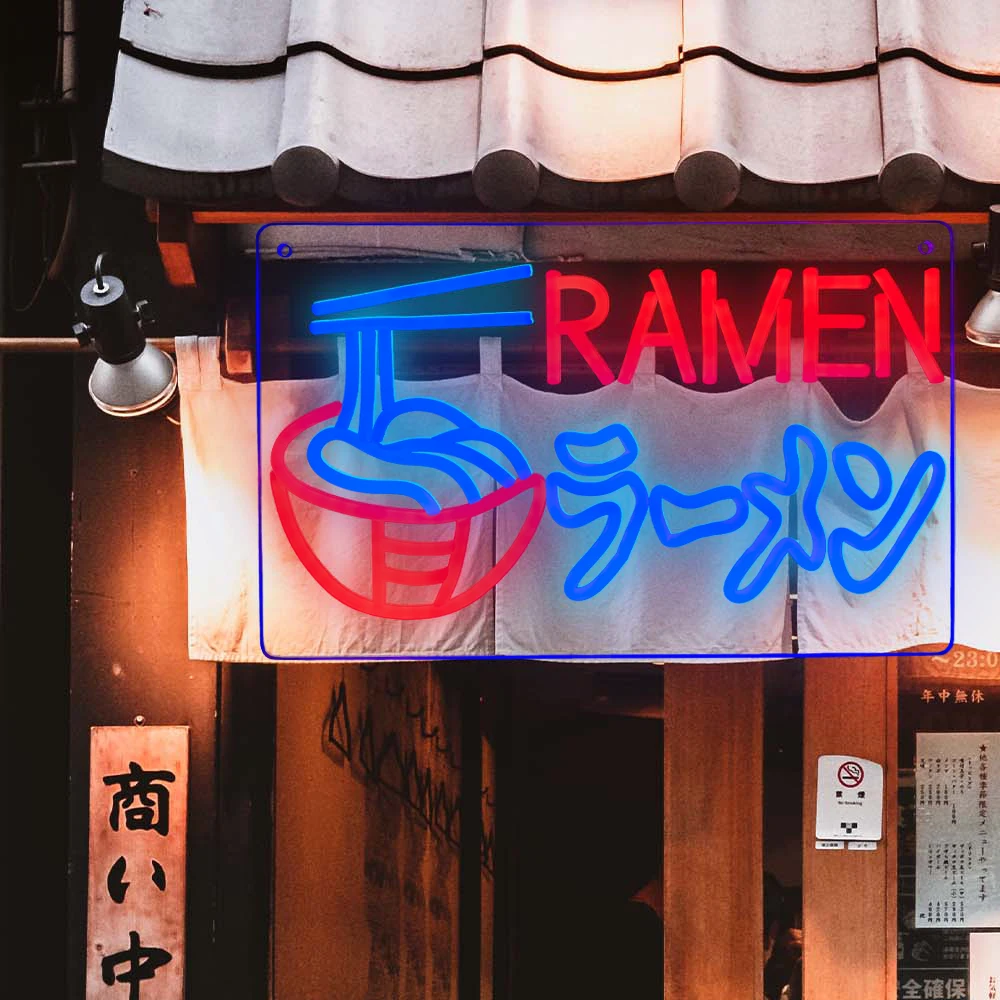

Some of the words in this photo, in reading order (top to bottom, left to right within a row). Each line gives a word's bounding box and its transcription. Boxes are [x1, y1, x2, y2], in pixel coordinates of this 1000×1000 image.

[546, 267, 945, 384] RAMEN
[546, 423, 946, 604] ラーメン
[920, 689, 985, 704] 年中無休
[897, 979, 967, 999] 全確保
